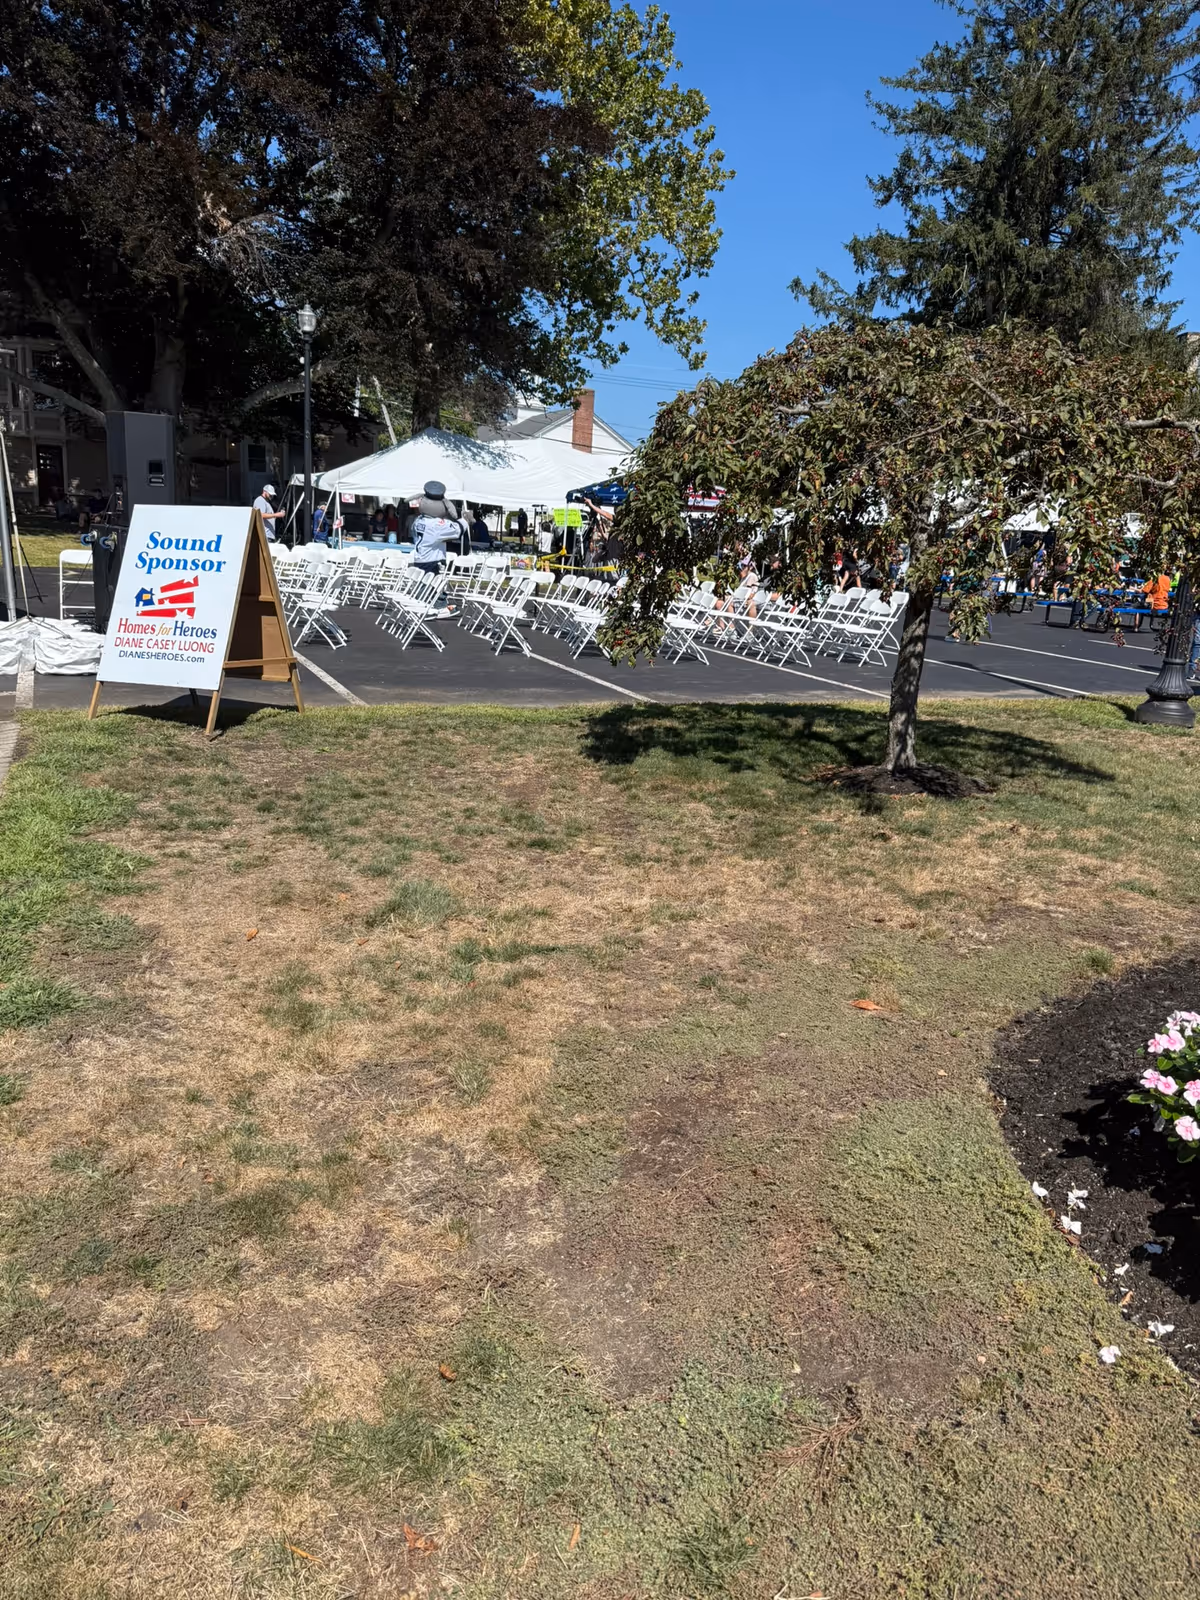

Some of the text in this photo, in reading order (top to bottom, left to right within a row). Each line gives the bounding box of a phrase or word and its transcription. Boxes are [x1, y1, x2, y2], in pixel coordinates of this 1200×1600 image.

[146, 531, 223, 553] Sound
[135, 551, 227, 575] Sponsor
[117, 618, 218, 639] Homes for Heroes
[114, 637, 215, 654] DIANE CASEY LUONG
[118, 650, 205, 663] DIANESHEROES.com
